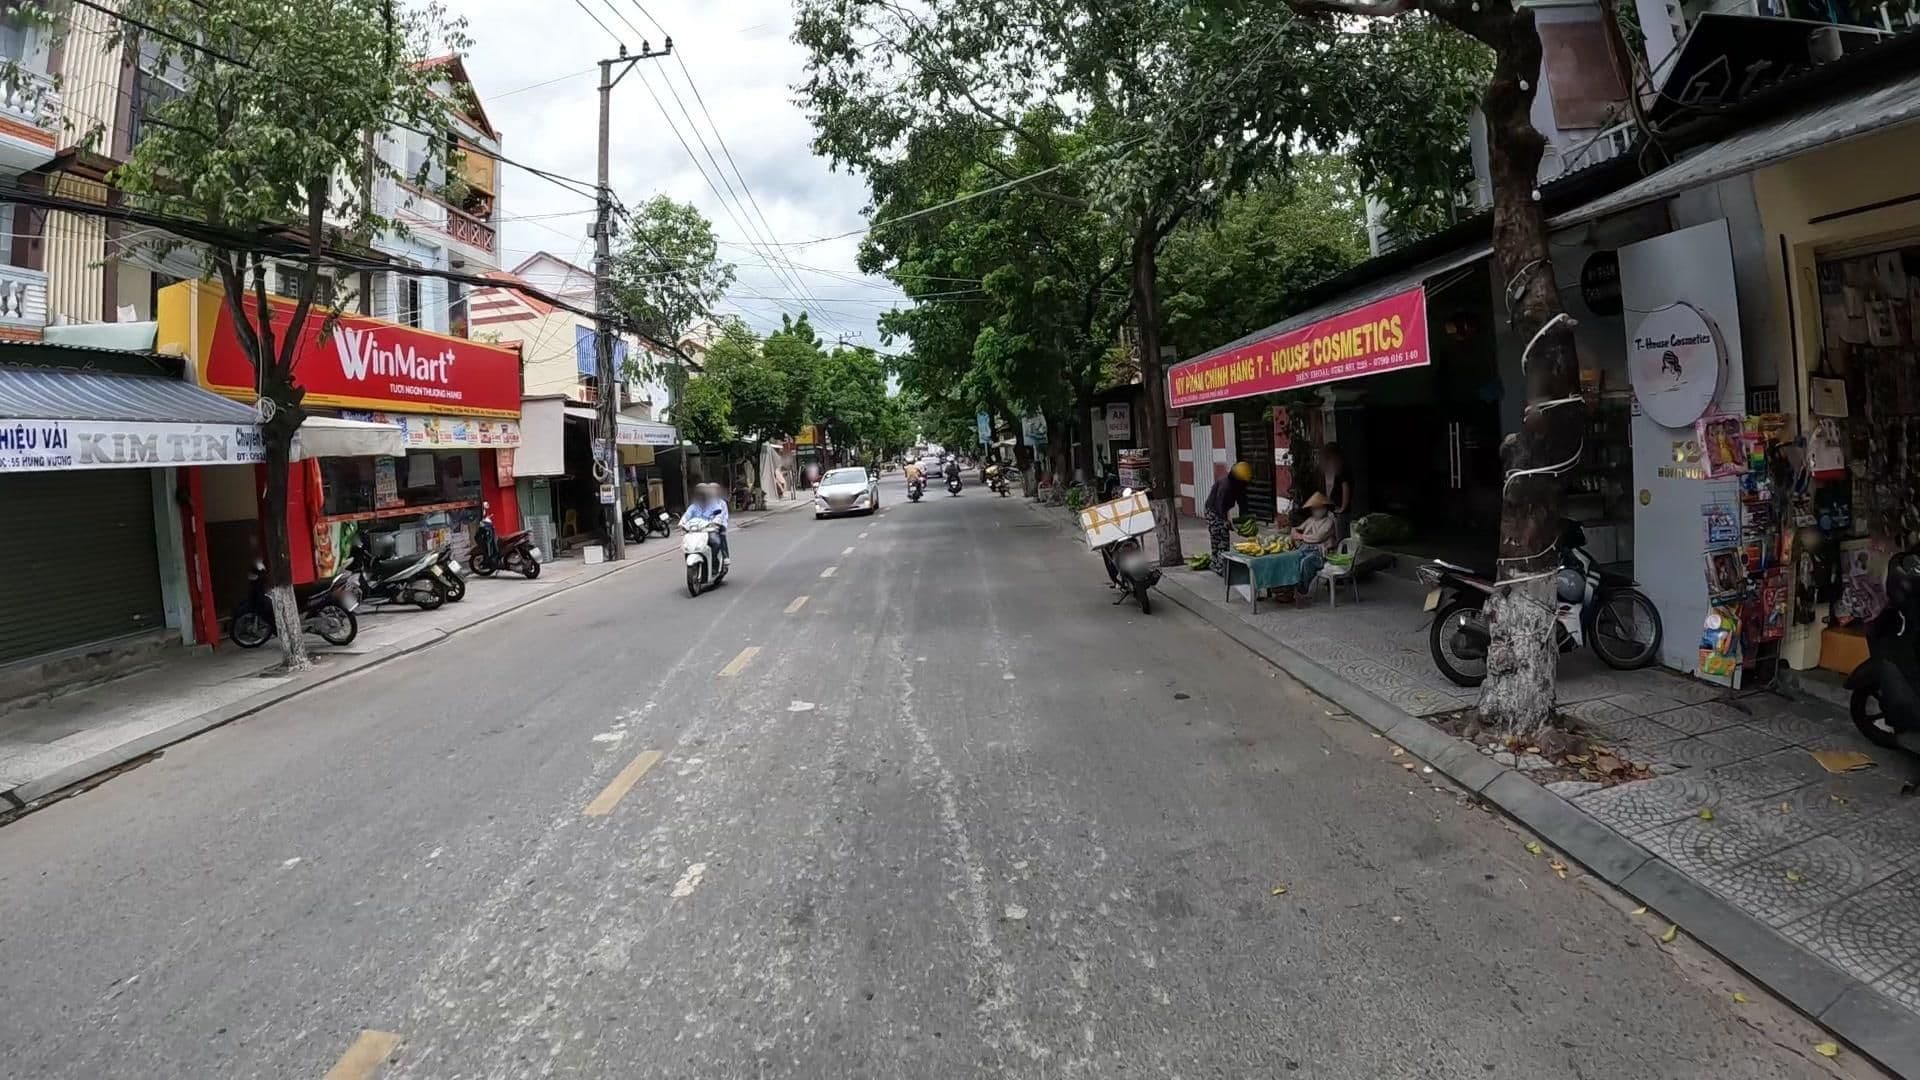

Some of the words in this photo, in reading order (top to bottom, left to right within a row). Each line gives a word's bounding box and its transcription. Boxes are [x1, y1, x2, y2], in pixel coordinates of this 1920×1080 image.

[1257, 355, 1264, 378] T
[1271, 341, 1311, 375] HOUSE
[1313, 314, 1404, 366] COSMETICS
[1670, 333, 1711, 347] Cosmetics
[42, 421, 68, 449] VẢI
[78, 432, 160, 464] KIM
[166, 426, 230, 462] TÍN
